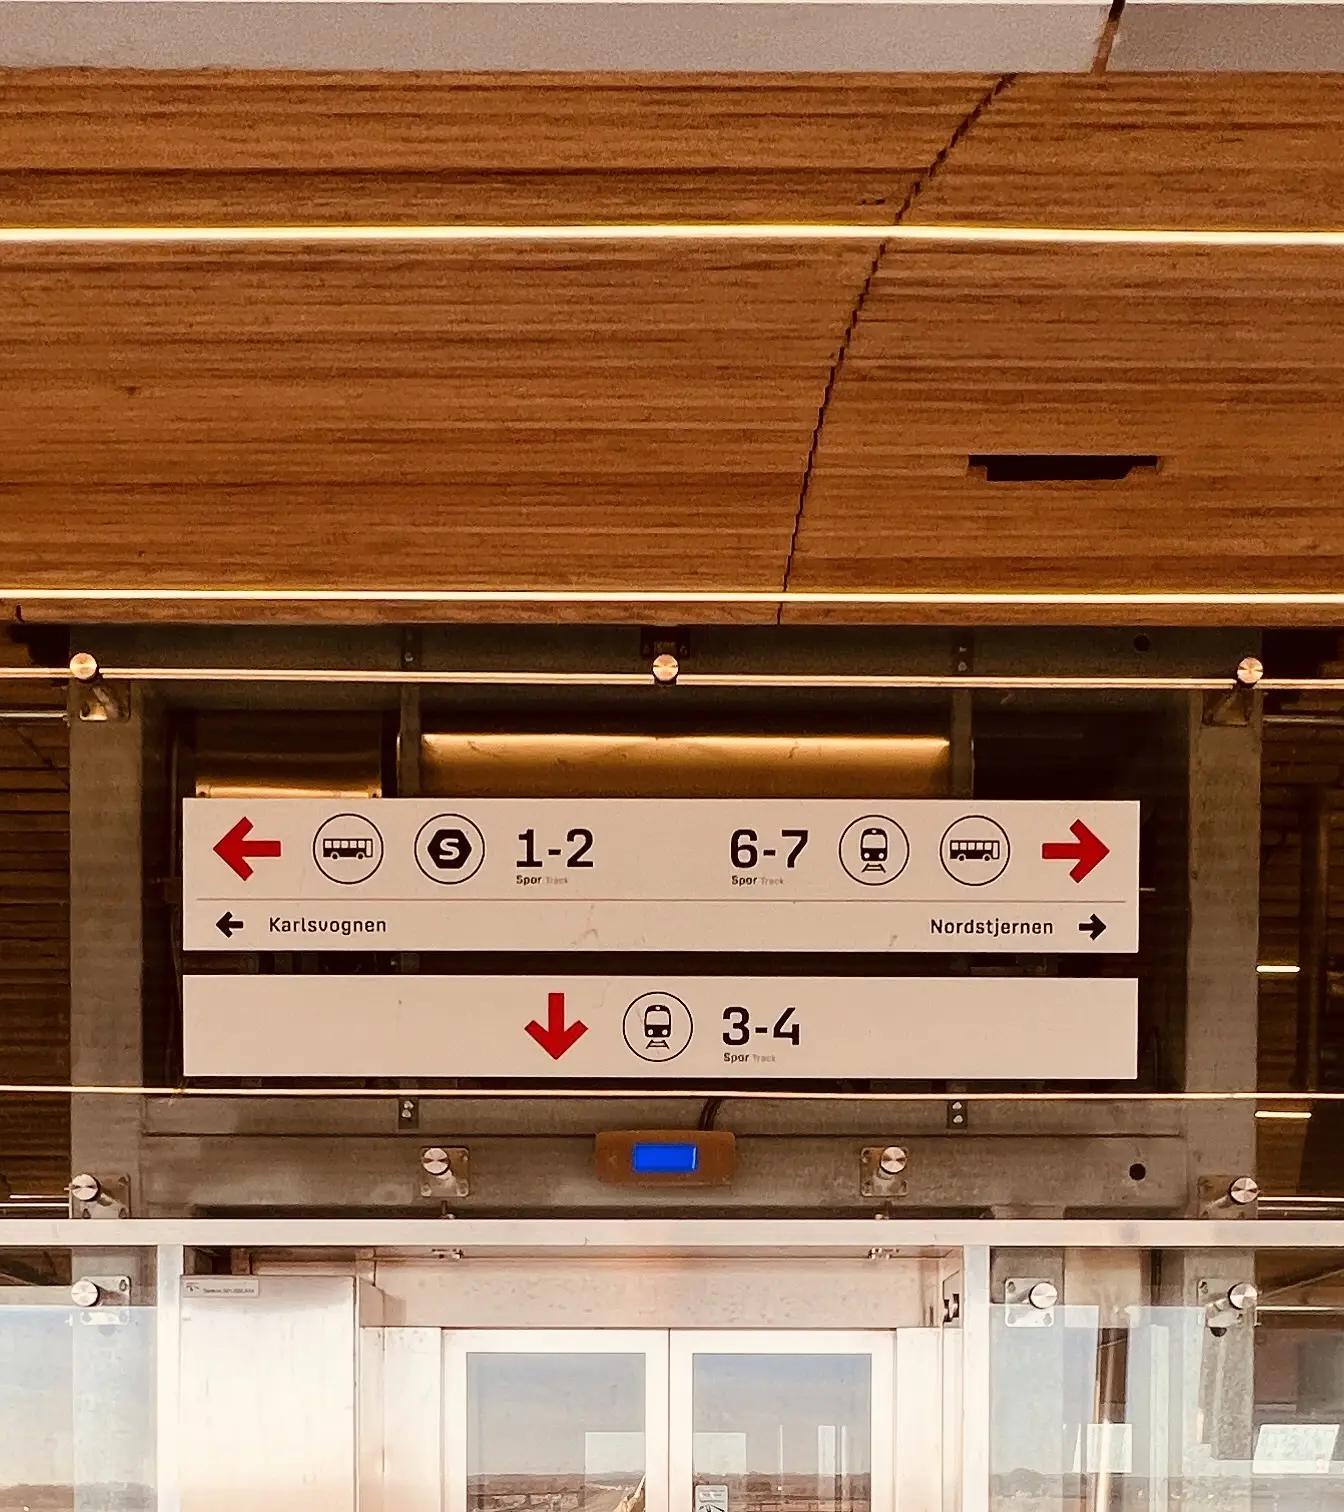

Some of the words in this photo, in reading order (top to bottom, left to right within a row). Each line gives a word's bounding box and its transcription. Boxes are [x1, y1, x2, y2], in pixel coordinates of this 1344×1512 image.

[439, 838, 460, 861] S
[516, 828, 594, 868] 1-2
[730, 828, 809, 869] 6-7
[516, 874, 543, 886] Spor
[731, 874, 758, 887] Spor
[269, 917, 387, 935] Karlsvognen
[930, 918, 1053, 937] Nordstjernen
[722, 1006, 800, 1046] 3-4
[723, 1052, 750, 1064] Spor
